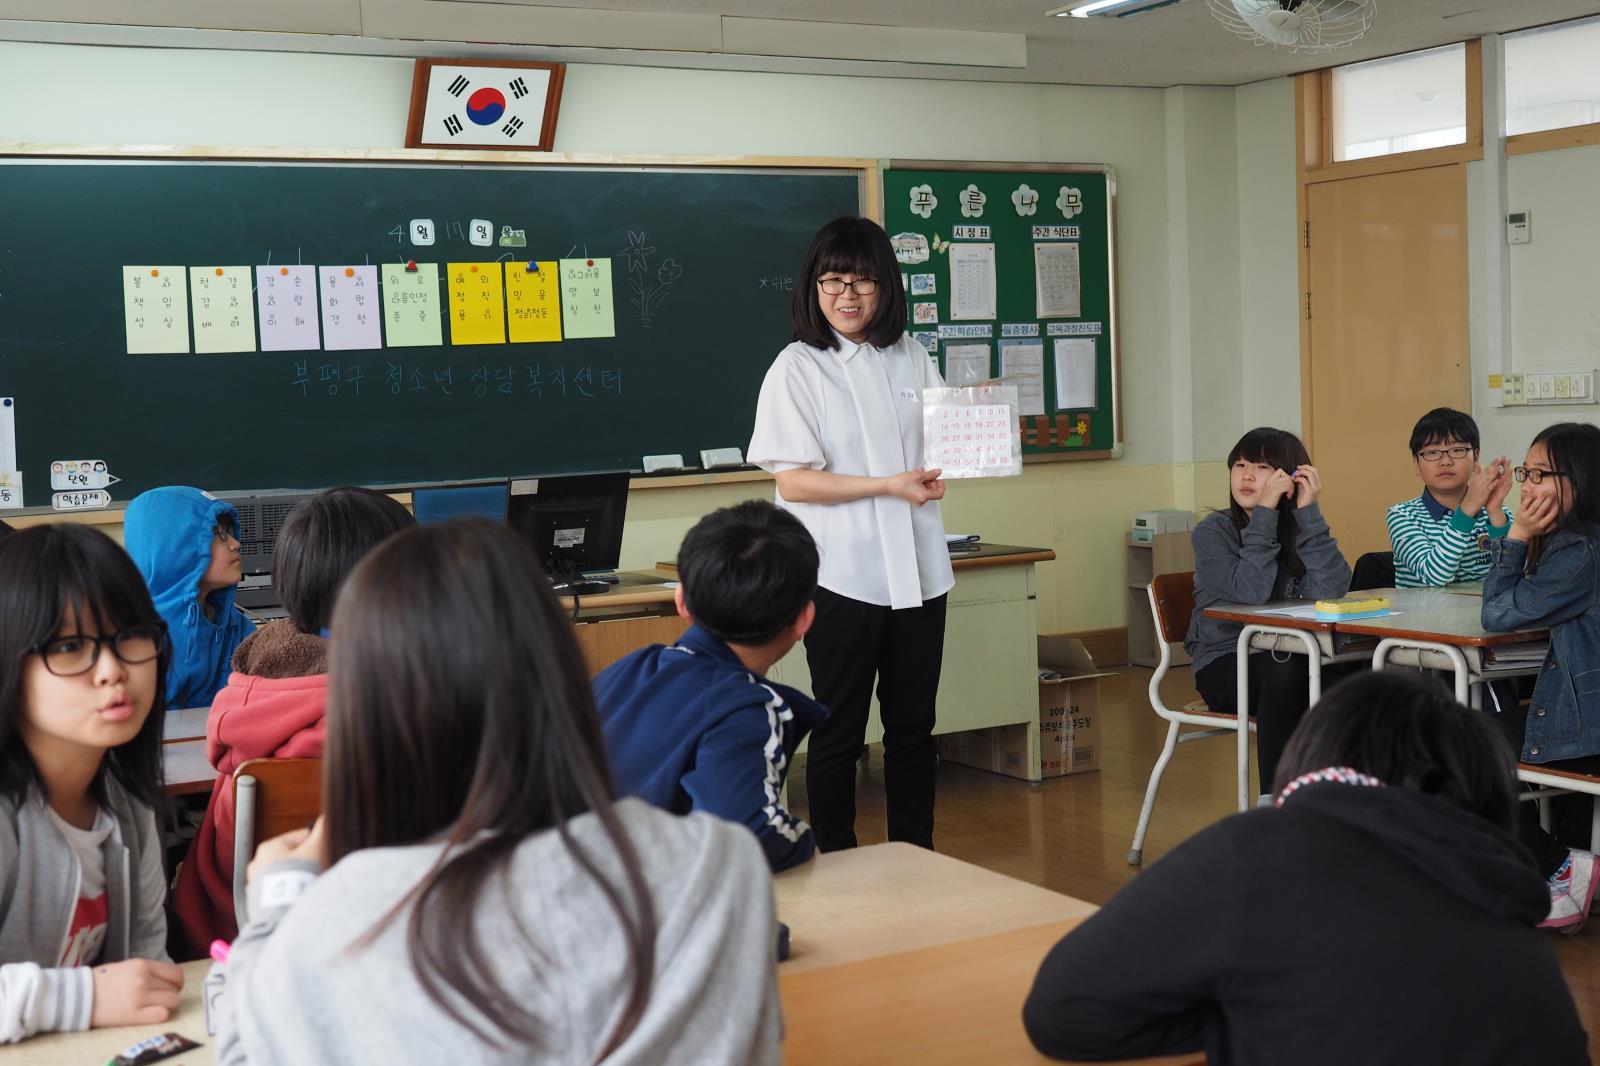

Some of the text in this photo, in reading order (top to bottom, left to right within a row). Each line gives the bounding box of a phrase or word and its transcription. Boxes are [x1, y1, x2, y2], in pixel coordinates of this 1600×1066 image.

[916, 191, 1080, 212] 푸 른 나 무
[417, 224, 429, 239] 월
[476, 225, 487, 239] 일
[385, 361, 453, 396] 청소년
[68, 474, 89, 486] 단원
